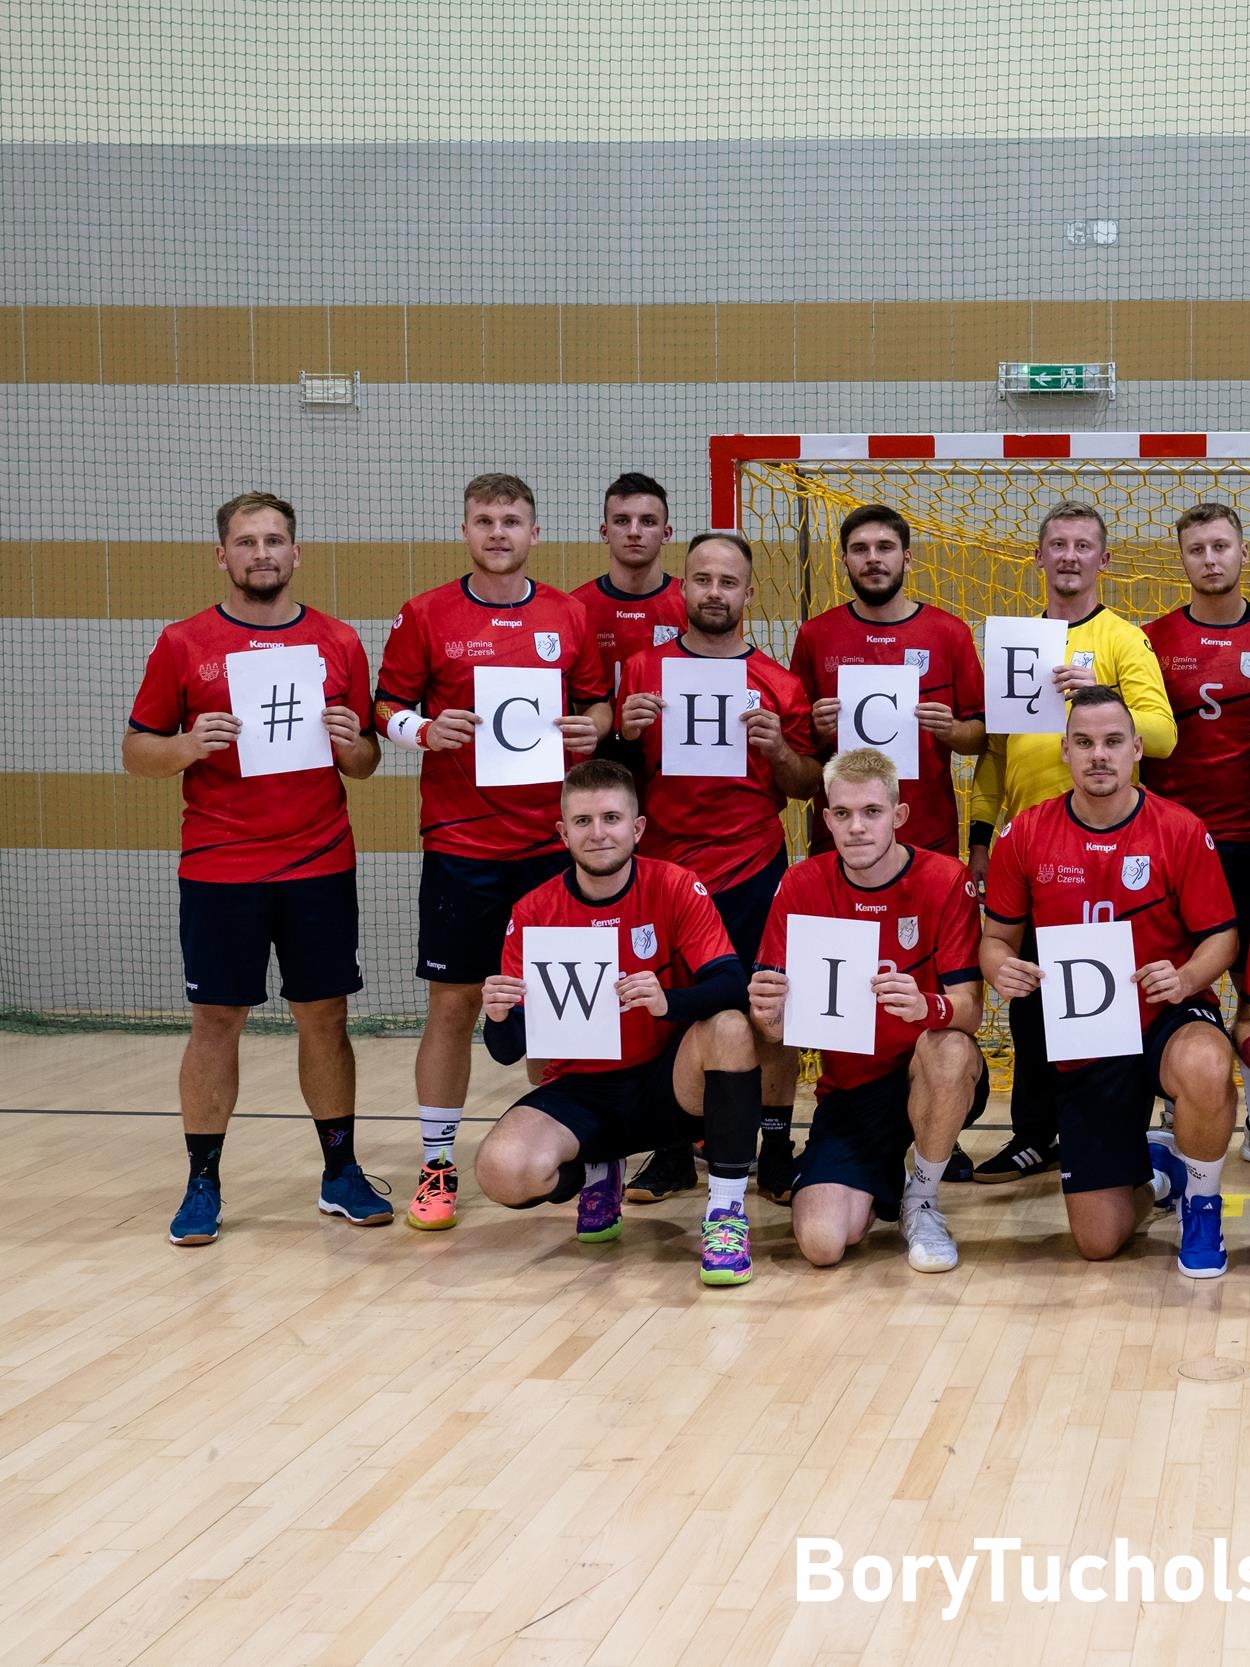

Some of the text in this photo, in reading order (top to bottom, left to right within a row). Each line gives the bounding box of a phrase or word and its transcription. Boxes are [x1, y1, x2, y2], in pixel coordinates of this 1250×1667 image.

[616, 610, 646, 620] Kempa
[491, 618, 523, 628] Kempa
[467, 640, 493, 649] Gmina
[866, 635, 896, 645] Kempa
[1200, 637, 1232, 647] Kempa
[467, 648, 496, 657] Czersk
[842, 656, 865, 664] Gmina
[1172, 656, 1197, 664] Gmina
[1171, 663, 1198, 671] Czersk
[1000, 646, 1042, 715] Ę
[260, 682, 304, 744] #
[492, 697, 542, 752] C
[679, 693, 734, 747] H
[853, 692, 899, 746] C
[1086, 842, 1117, 854] Kempa
[1057, 864, 1085, 875] Gmina
[1057, 874, 1086, 884] Czersk
[855, 903, 887, 914] Kempa
[590, 917, 620, 928] Kempa
[530, 961, 613, 1021] W
[820, 957, 847, 1018] I
[1053, 958, 1116, 1020] D
[1187, 1007, 1218, 1023] 10
